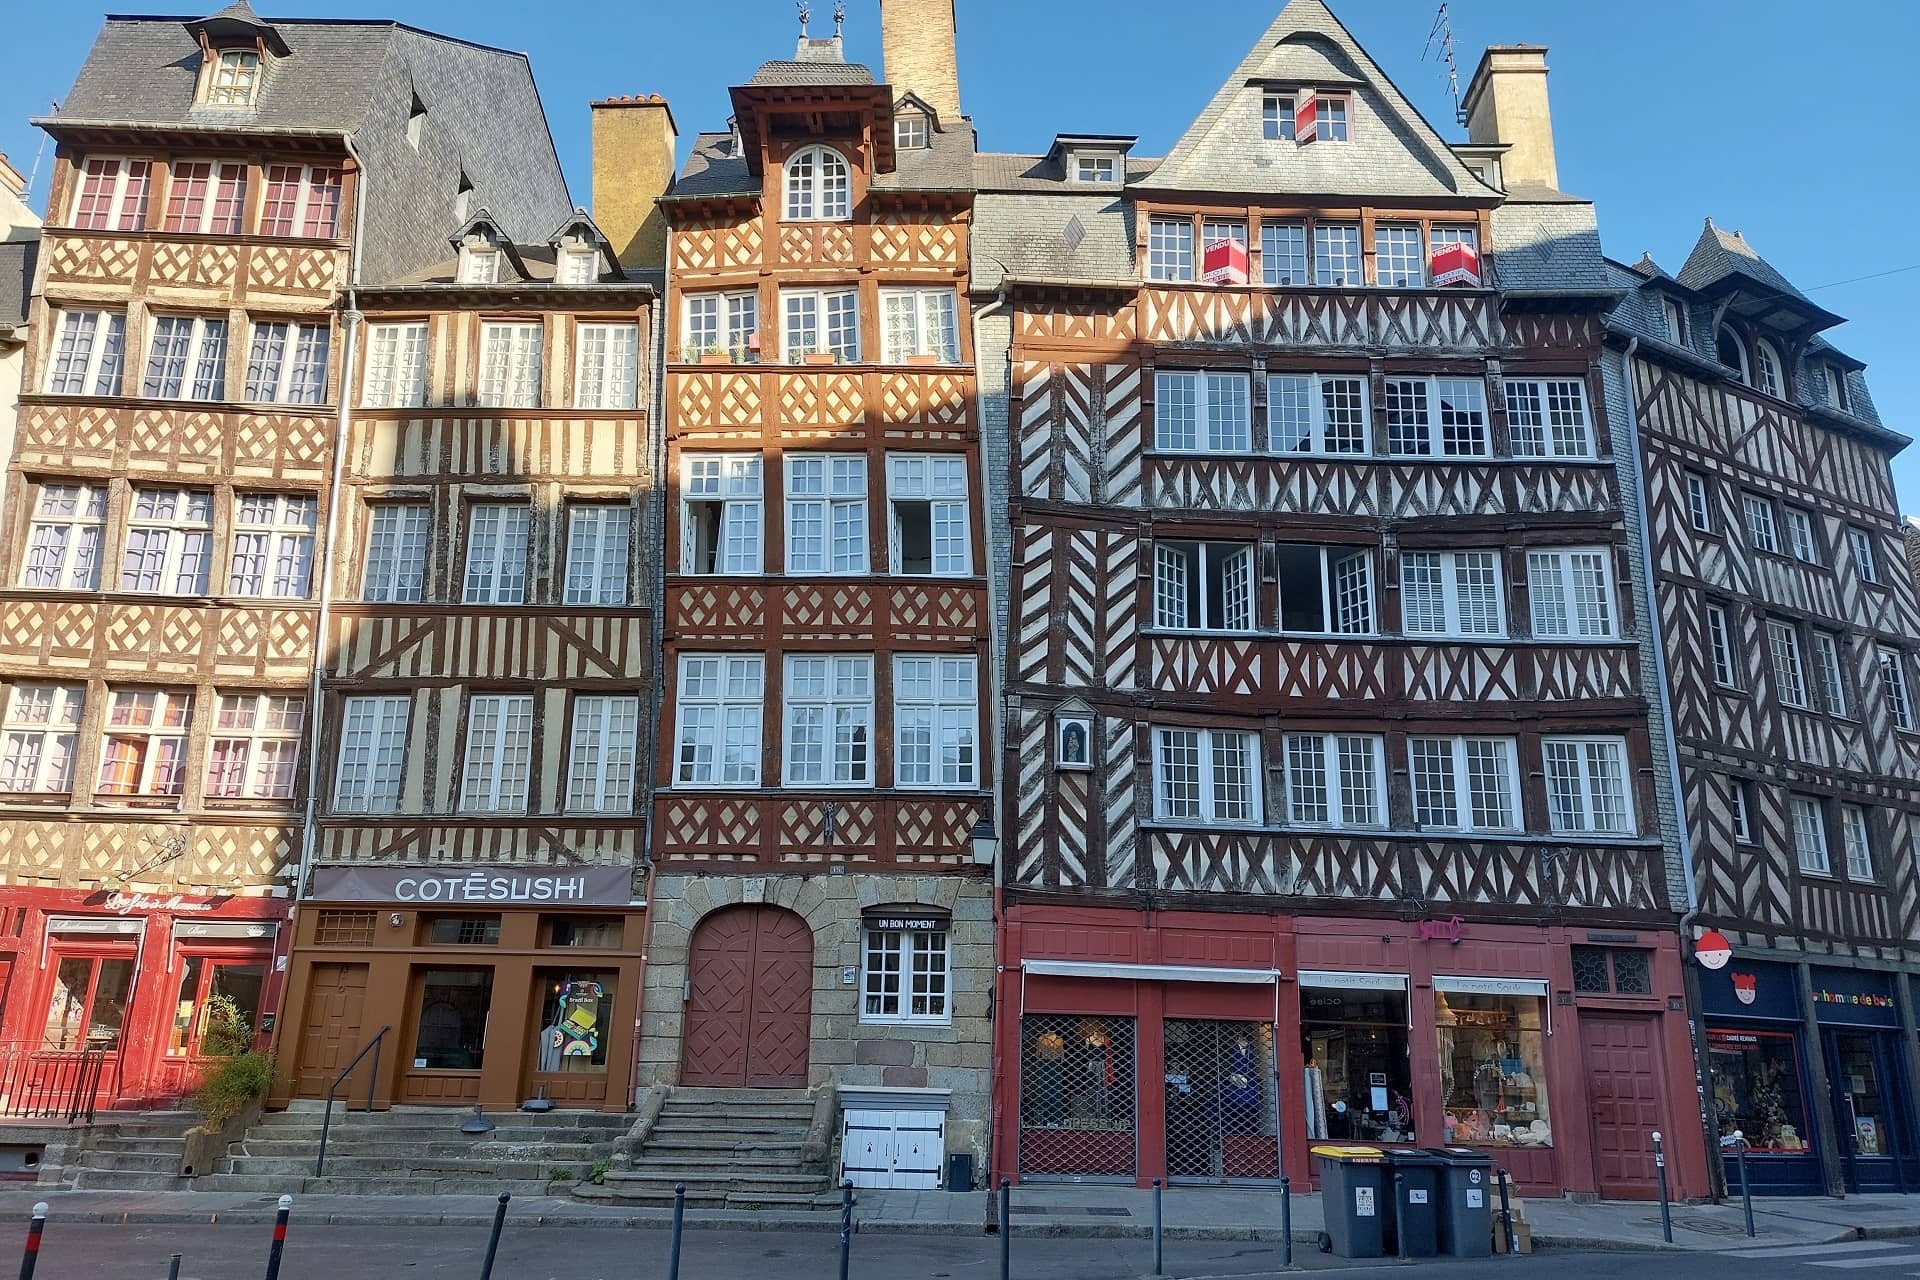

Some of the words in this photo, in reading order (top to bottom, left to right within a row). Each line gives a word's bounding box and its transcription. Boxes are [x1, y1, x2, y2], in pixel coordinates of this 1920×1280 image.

[1205, 239, 1229, 253] VENDU
[1432, 243, 1460, 257] VENDU
[879, 920, 889, 928] UN
[890, 920, 904, 928] BON
[905, 920, 936, 928] MOMENT
[1860, 993, 1872, 1005] de
